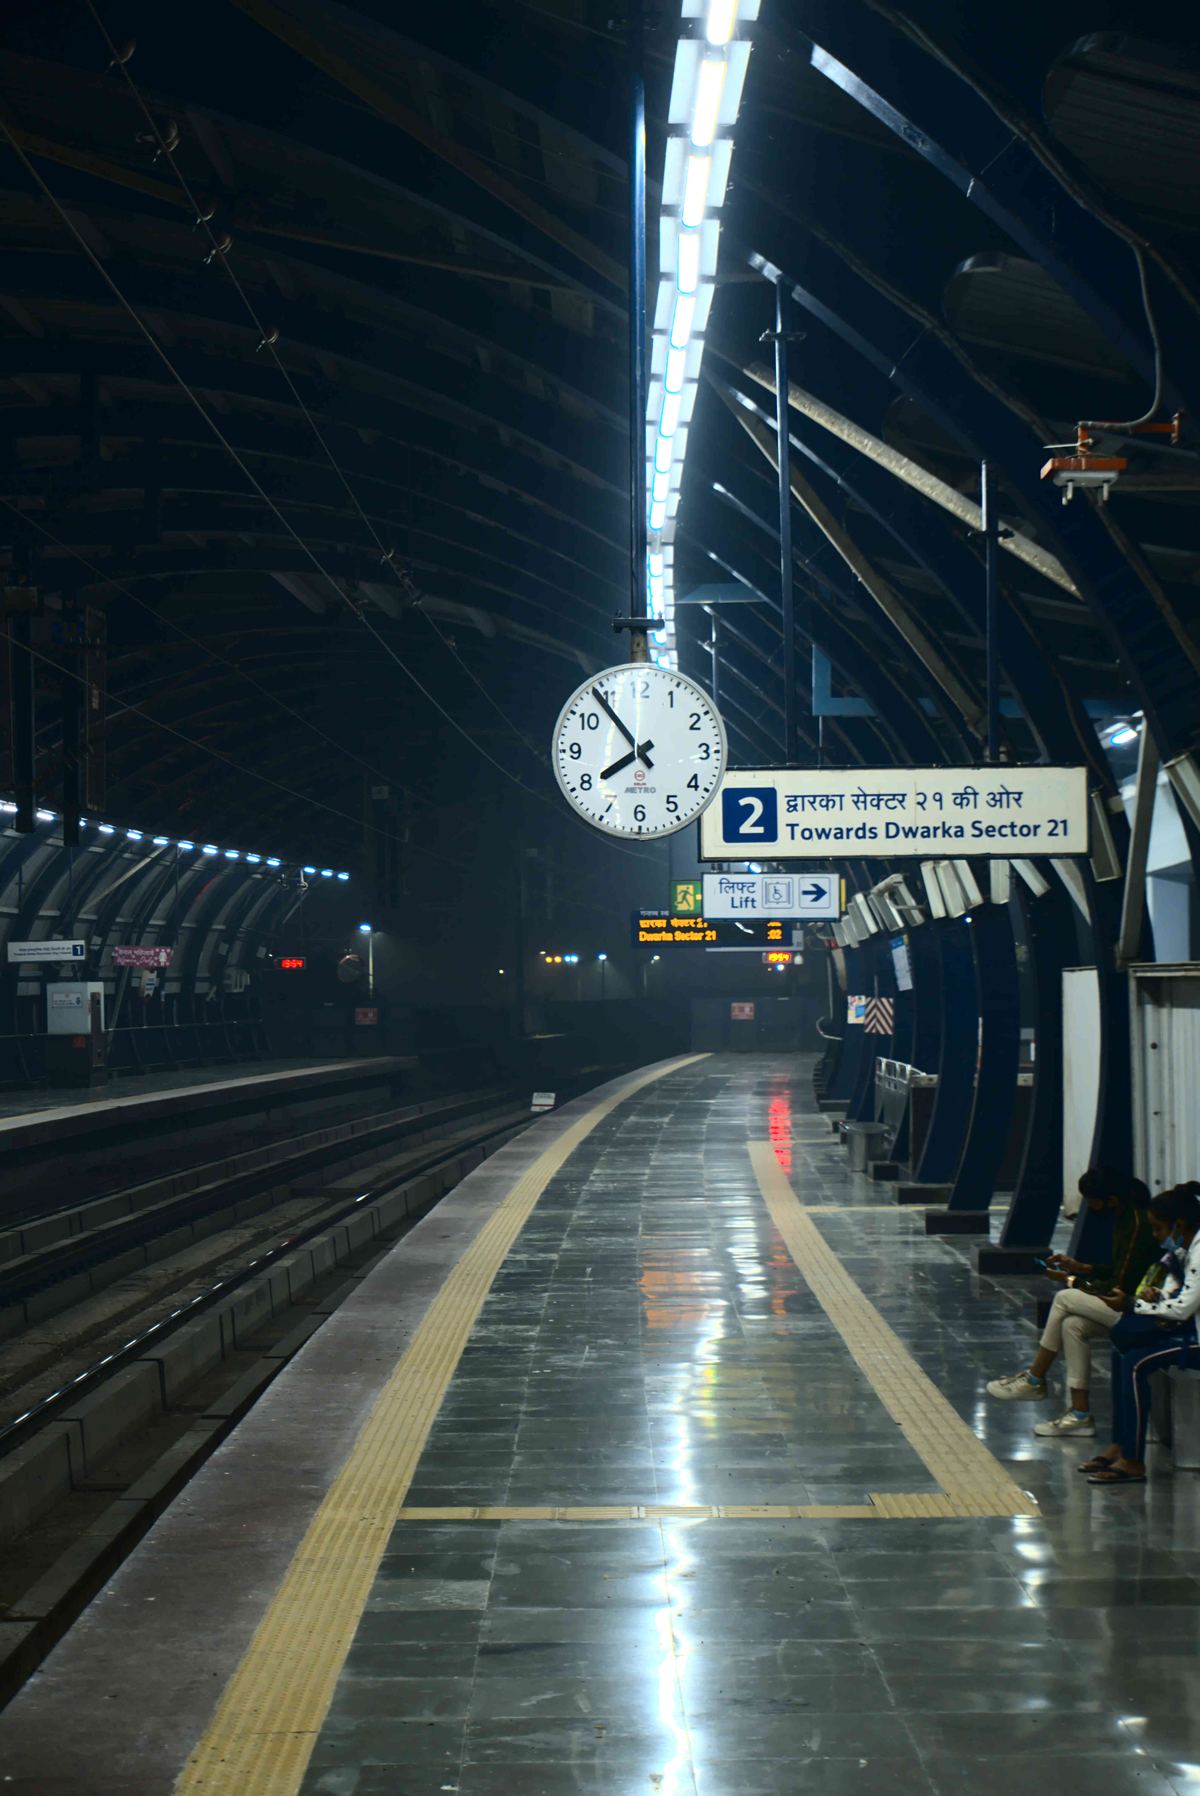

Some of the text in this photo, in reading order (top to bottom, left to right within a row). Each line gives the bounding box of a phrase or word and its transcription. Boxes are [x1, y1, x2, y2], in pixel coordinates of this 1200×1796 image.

[630, 681, 650, 698] 12
[603, 690, 616, 708] 11
[667, 690, 674, 709] 1
[579, 712, 600, 731] 10
[689, 712, 701, 731] 2
[569, 742, 582, 760] 9
[698, 742, 710, 760] 3
[580, 773, 592, 791] 8
[624, 786, 656, 794] METRO
[687, 773, 700, 791] 4
[604, 794, 618, 813] 7
[666, 794, 679, 813] 5
[785, 785, 1023, 813] द्वारका सेक्टर २१ की ओर
[633, 804, 646, 822] 6
[737, 796, 765, 834] 2
[785, 820, 1069, 840] Towards Dwarka Sector 21
[718, 877, 757, 895] लिफ्ट
[730, 897, 757, 909] Lift
[705, 930, 717, 941] 21
[76, 946, 81, 955] 1
